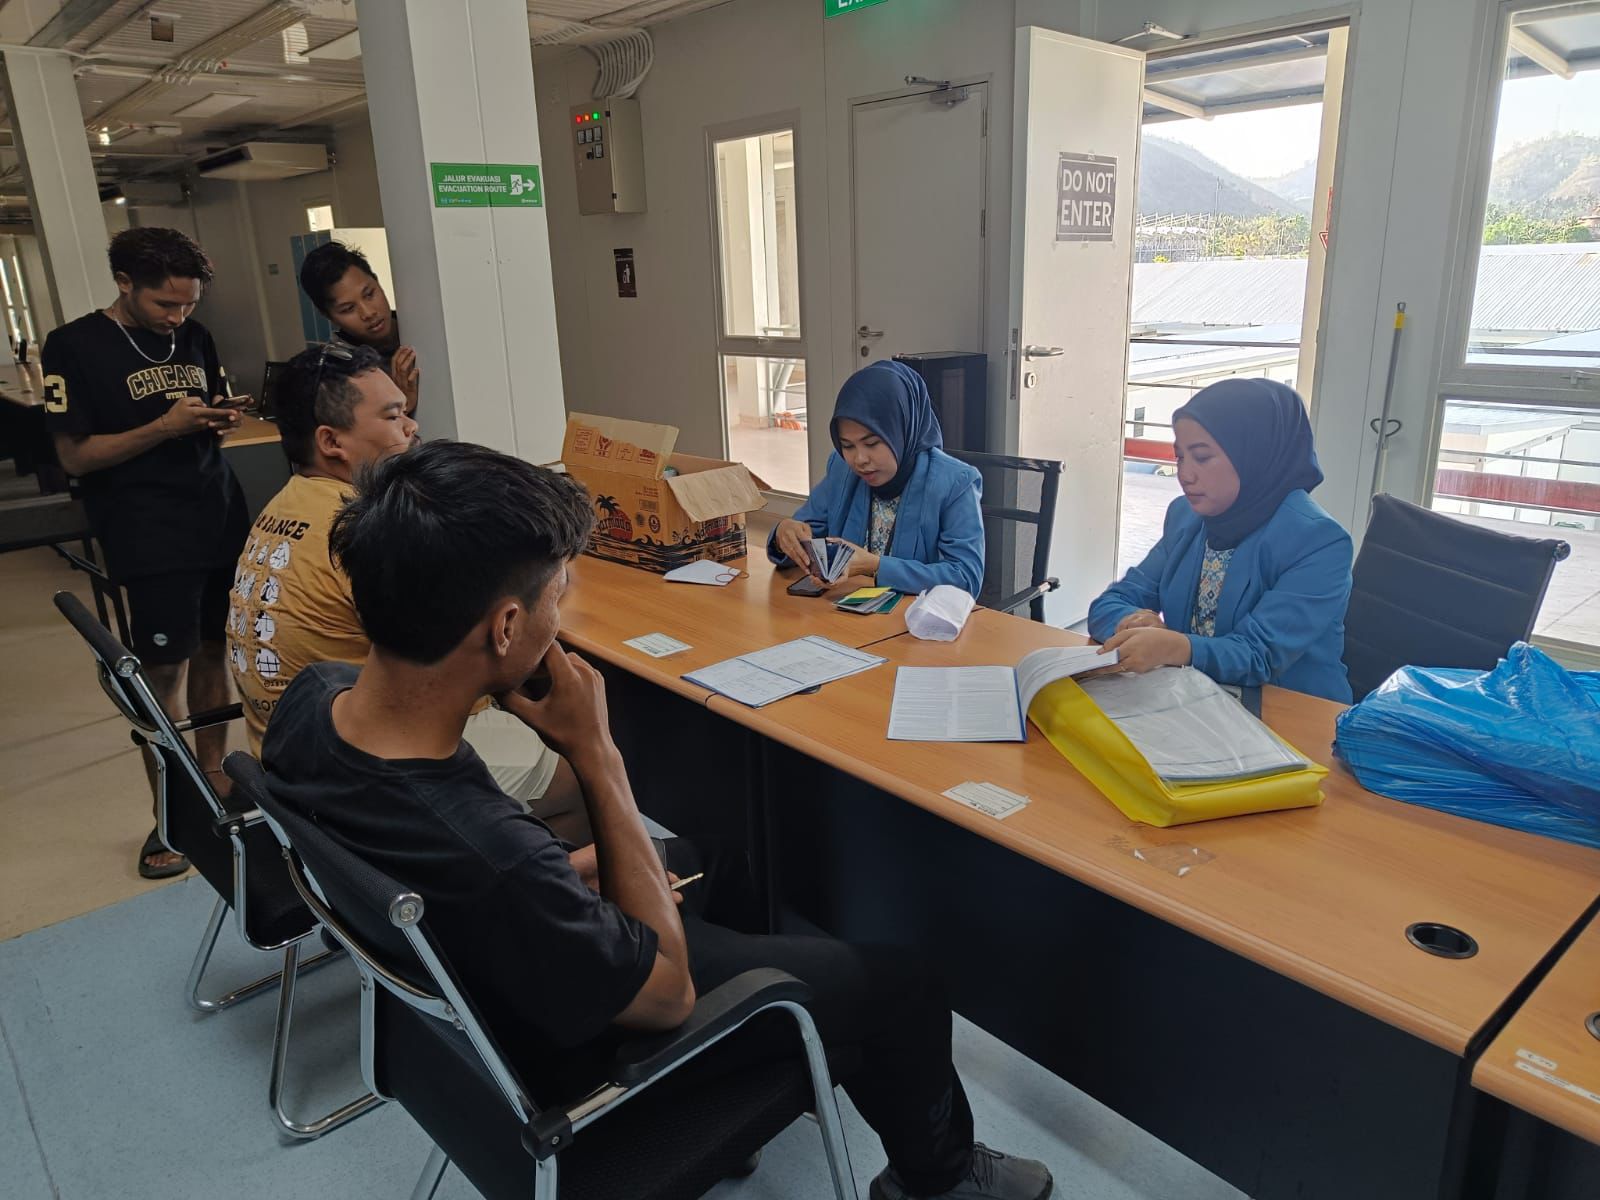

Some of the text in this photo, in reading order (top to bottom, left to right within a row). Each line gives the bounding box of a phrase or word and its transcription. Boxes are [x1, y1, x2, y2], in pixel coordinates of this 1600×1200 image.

[439, 185, 507, 193] EVACUATION ROUTE
[467, 175, 501, 183] EVAKUASI
[1063, 169, 1113, 193] DO NOT
[1061, 199, 1111, 226] ENTER
[44, 374, 68, 413] 3
